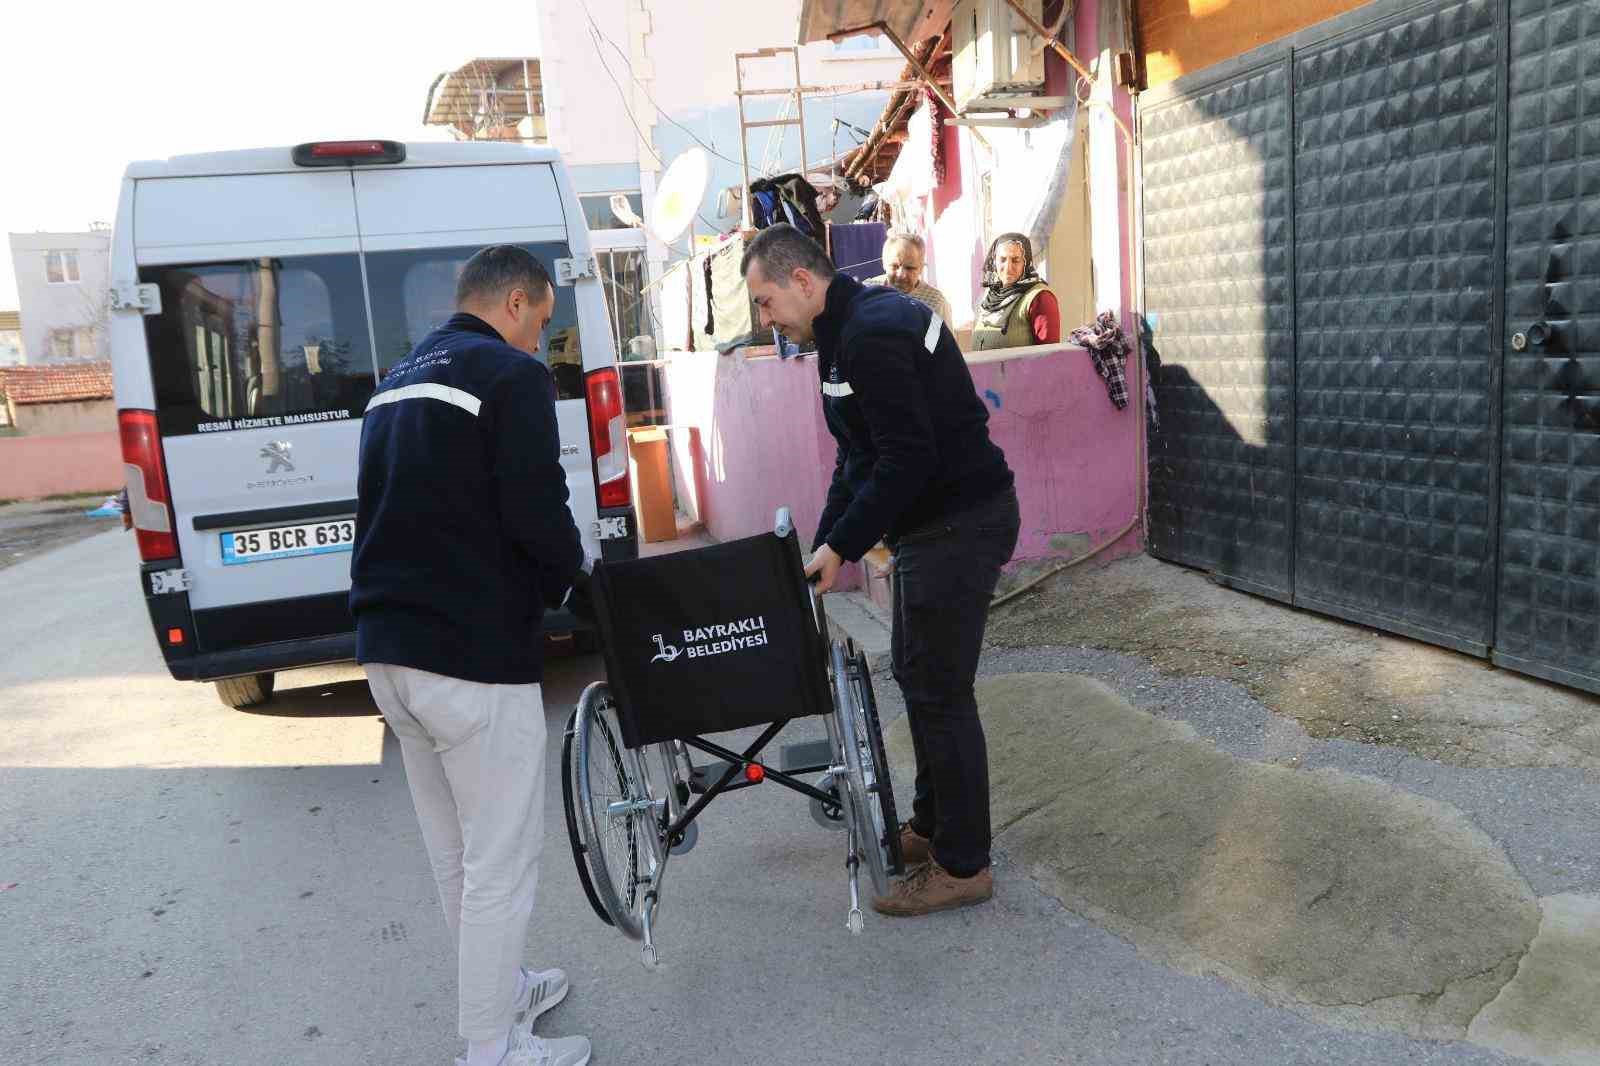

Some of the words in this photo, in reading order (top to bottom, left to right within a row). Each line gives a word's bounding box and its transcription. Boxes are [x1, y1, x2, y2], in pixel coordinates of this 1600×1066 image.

[197, 421, 232, 432] RESMİ
[234, 416, 282, 429] HİZMETE
[284, 409, 350, 425] MAHSUSTUR
[235, 533, 260, 554] 35
[268, 528, 307, 551] BCR
[315, 523, 353, 545] 633
[683, 616, 765, 642] BAYRAKLI
[686, 630, 768, 658] BELEDİYESİ
